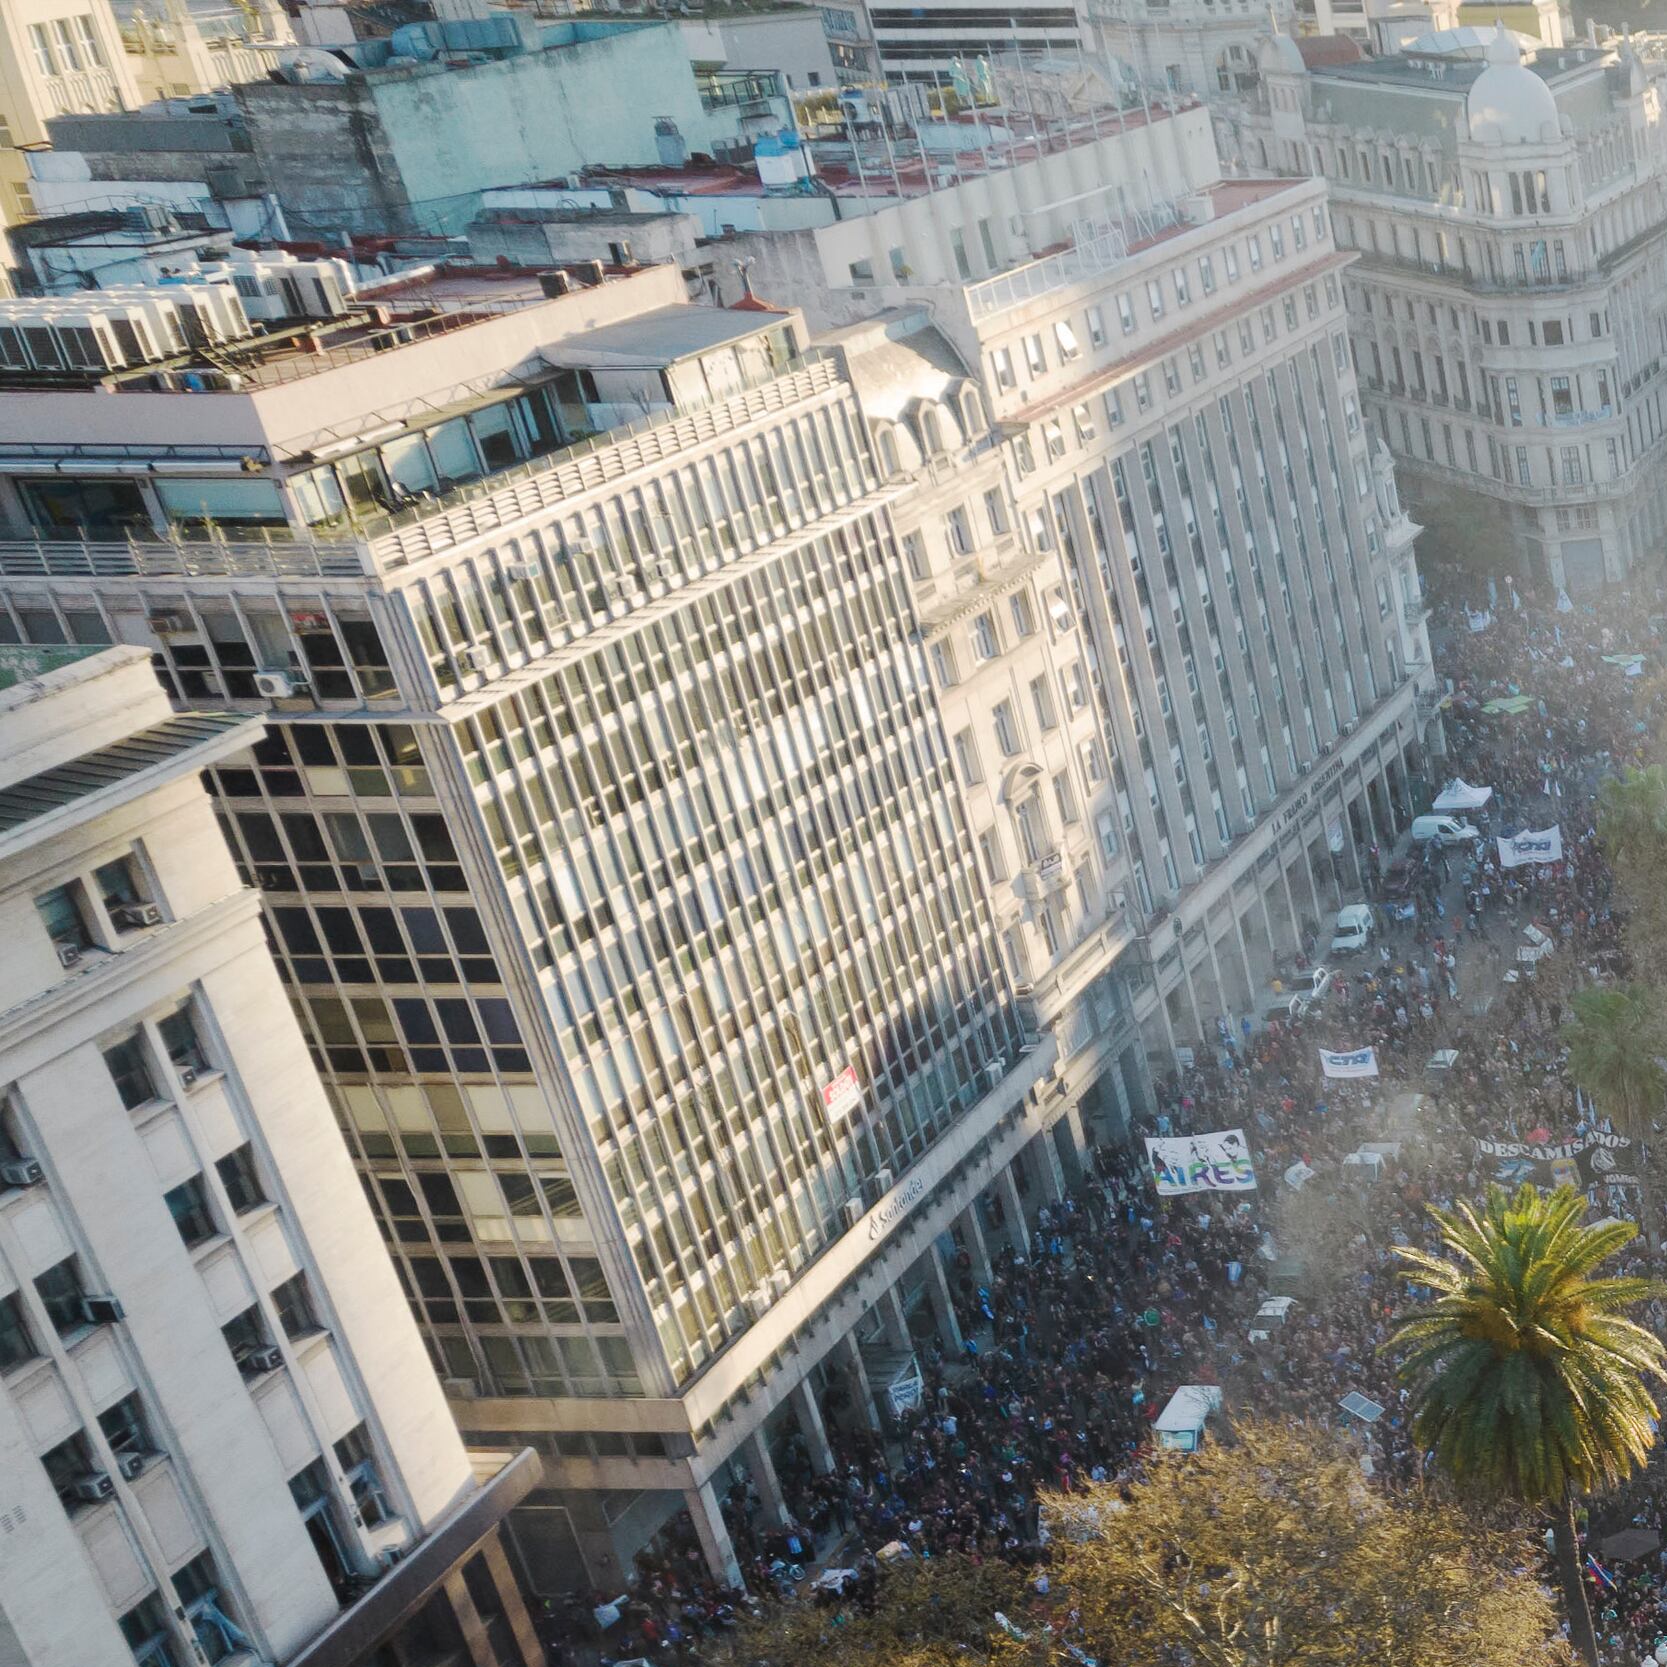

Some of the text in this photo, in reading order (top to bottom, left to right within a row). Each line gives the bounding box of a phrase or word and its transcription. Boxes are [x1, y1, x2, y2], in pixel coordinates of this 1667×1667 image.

[1480, 1131, 1631, 1160] DESCAMISADOS
[1154, 1158, 1253, 1187] AIRES
[880, 1178, 925, 1229] Santander
